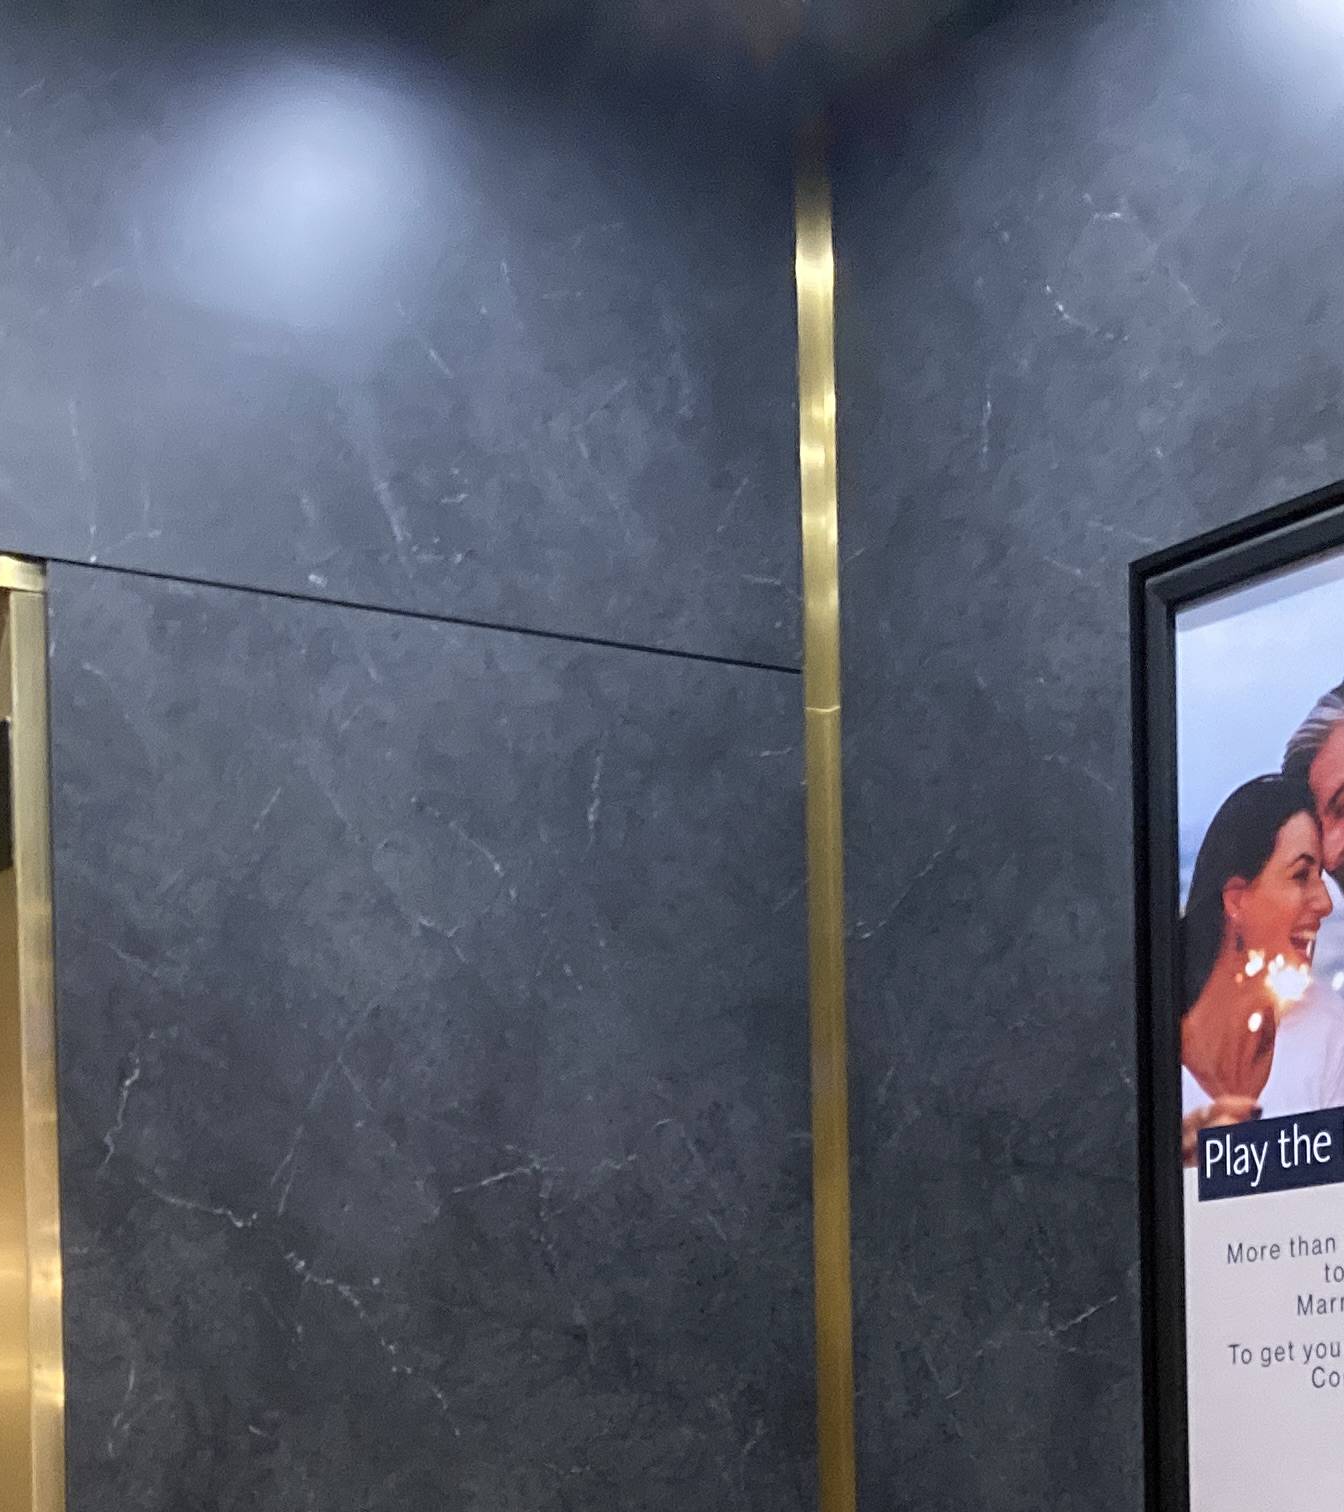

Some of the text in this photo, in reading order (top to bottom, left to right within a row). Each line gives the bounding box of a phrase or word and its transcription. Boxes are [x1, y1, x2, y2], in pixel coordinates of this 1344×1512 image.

[1206, 1134, 1268, 1187] Play
[1277, 1122, 1331, 1169] the
[1226, 1242, 1281, 1264] More
[1289, 1235, 1336, 1258] than
[1228, 1343, 1253, 1365] To
[1260, 1341, 1295, 1367] get
